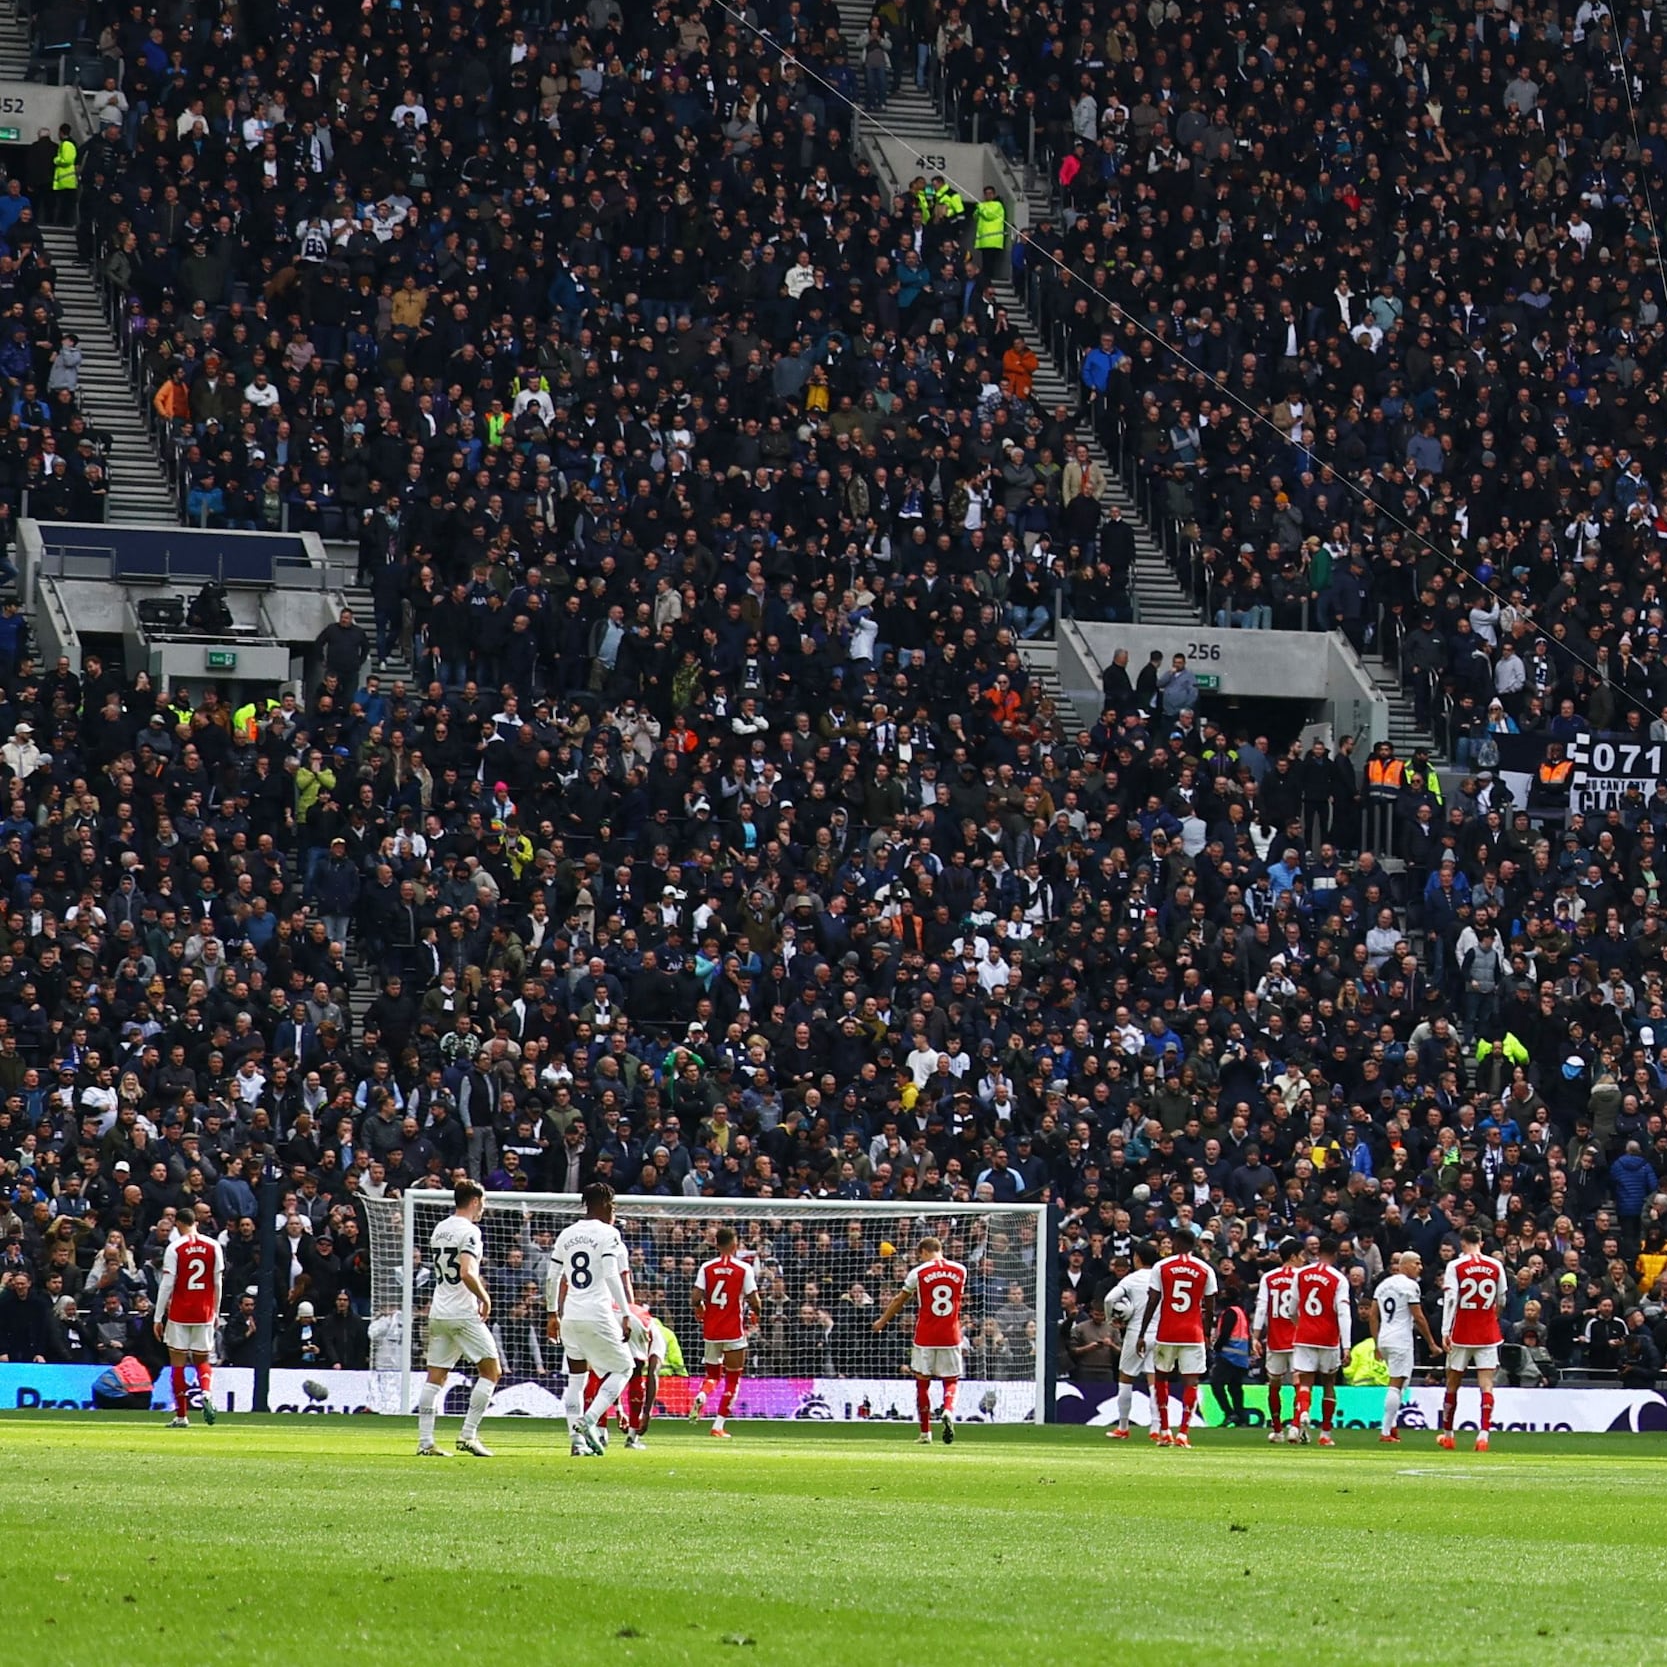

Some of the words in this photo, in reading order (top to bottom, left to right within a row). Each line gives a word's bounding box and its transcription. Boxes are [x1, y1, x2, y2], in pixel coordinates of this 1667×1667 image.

[0, 98, 24, 114] 52
[915, 155, 946, 170] 453
[1187, 643, 1220, 661] 256
[563, 1235, 599, 1251] BISSOUMA
[187, 1258, 206, 1290] 2
[432, 1247, 462, 1285] 33
[570, 1251, 593, 1289] 8
[1169, 1266, 1200, 1279] THOMAS
[1303, 1273, 1331, 1287] GABRIEL
[710, 1280, 728, 1309] 4
[931, 1284, 953, 1317] 8
[1170, 1280, 1193, 1313] 5
[1269, 1288, 1294, 1320] 18
[1304, 1287, 1323, 1317] 6
[1459, 1277, 1497, 1310] 29
[1383, 1297, 1396, 1324] 9
